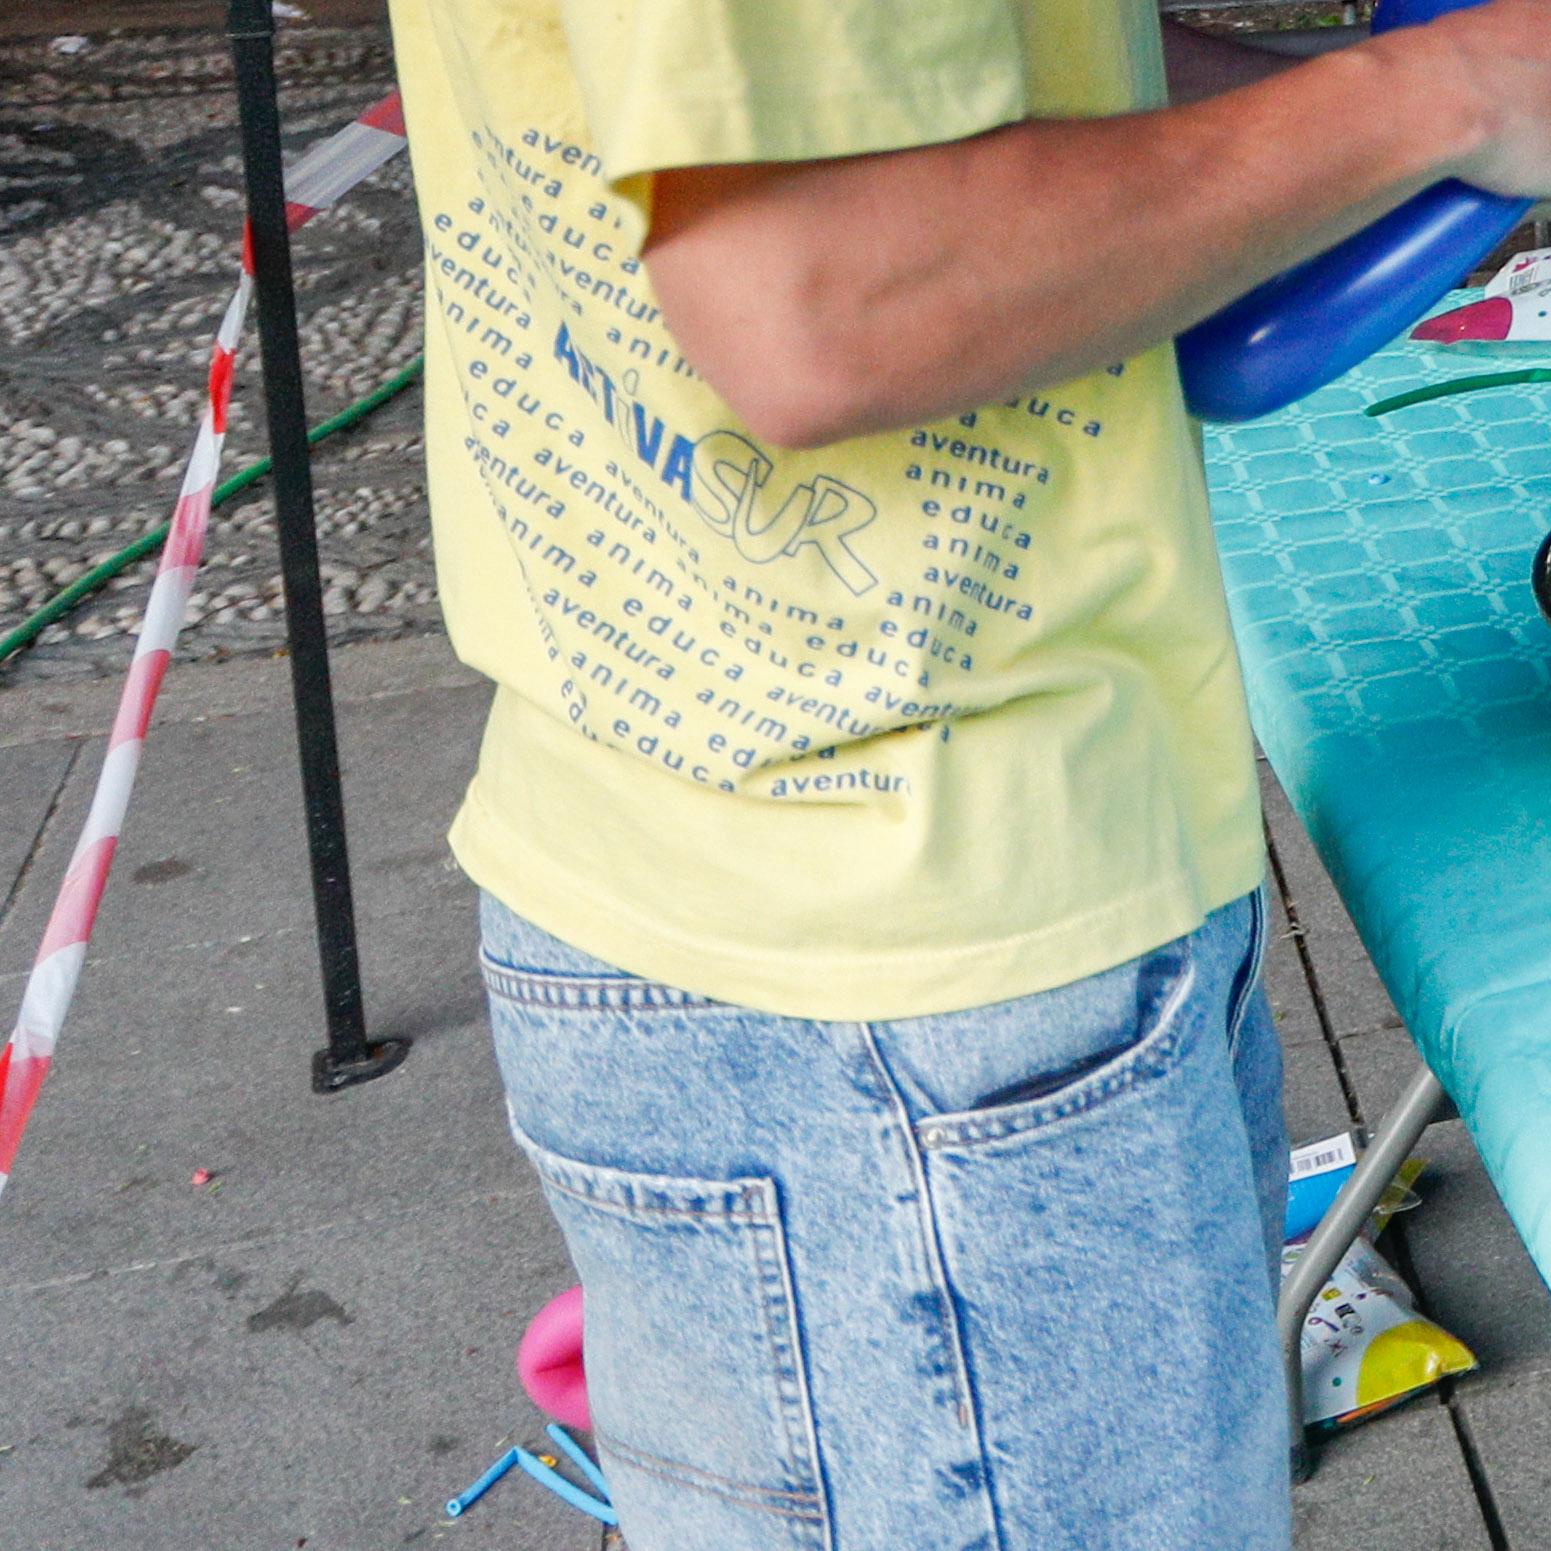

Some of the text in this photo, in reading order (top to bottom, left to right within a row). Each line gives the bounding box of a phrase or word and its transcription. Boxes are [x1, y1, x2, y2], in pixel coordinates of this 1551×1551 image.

[522, 127, 604, 177] aven
[430, 244, 532, 330] ventura
[547, 248, 661, 324] aventur
[436, 288, 533, 370] nima
[468, 359, 585, 448] educa
[904, 462, 1027, 510] anima
[910, 428, 1050, 486] aventura
[533, 448, 658, 545] aventura
[920, 498, 1033, 550] educa
[586, 527, 694, 612] anima
[922, 533, 1021, 581] anima
[722, 574, 845, 632] anima
[886, 589, 979, 638] anima
[923, 565, 1034, 622] aventura
[542, 587, 677, 682] aventura
[622, 597, 745, 682] educa
[718, 619, 844, 688] educa
[805, 634, 931, 689] educa
[879, 619, 974, 673] educa
[570, 651, 683, 730] anima
[696, 687, 812, 753] anima
[612, 717, 737, 794] educa
